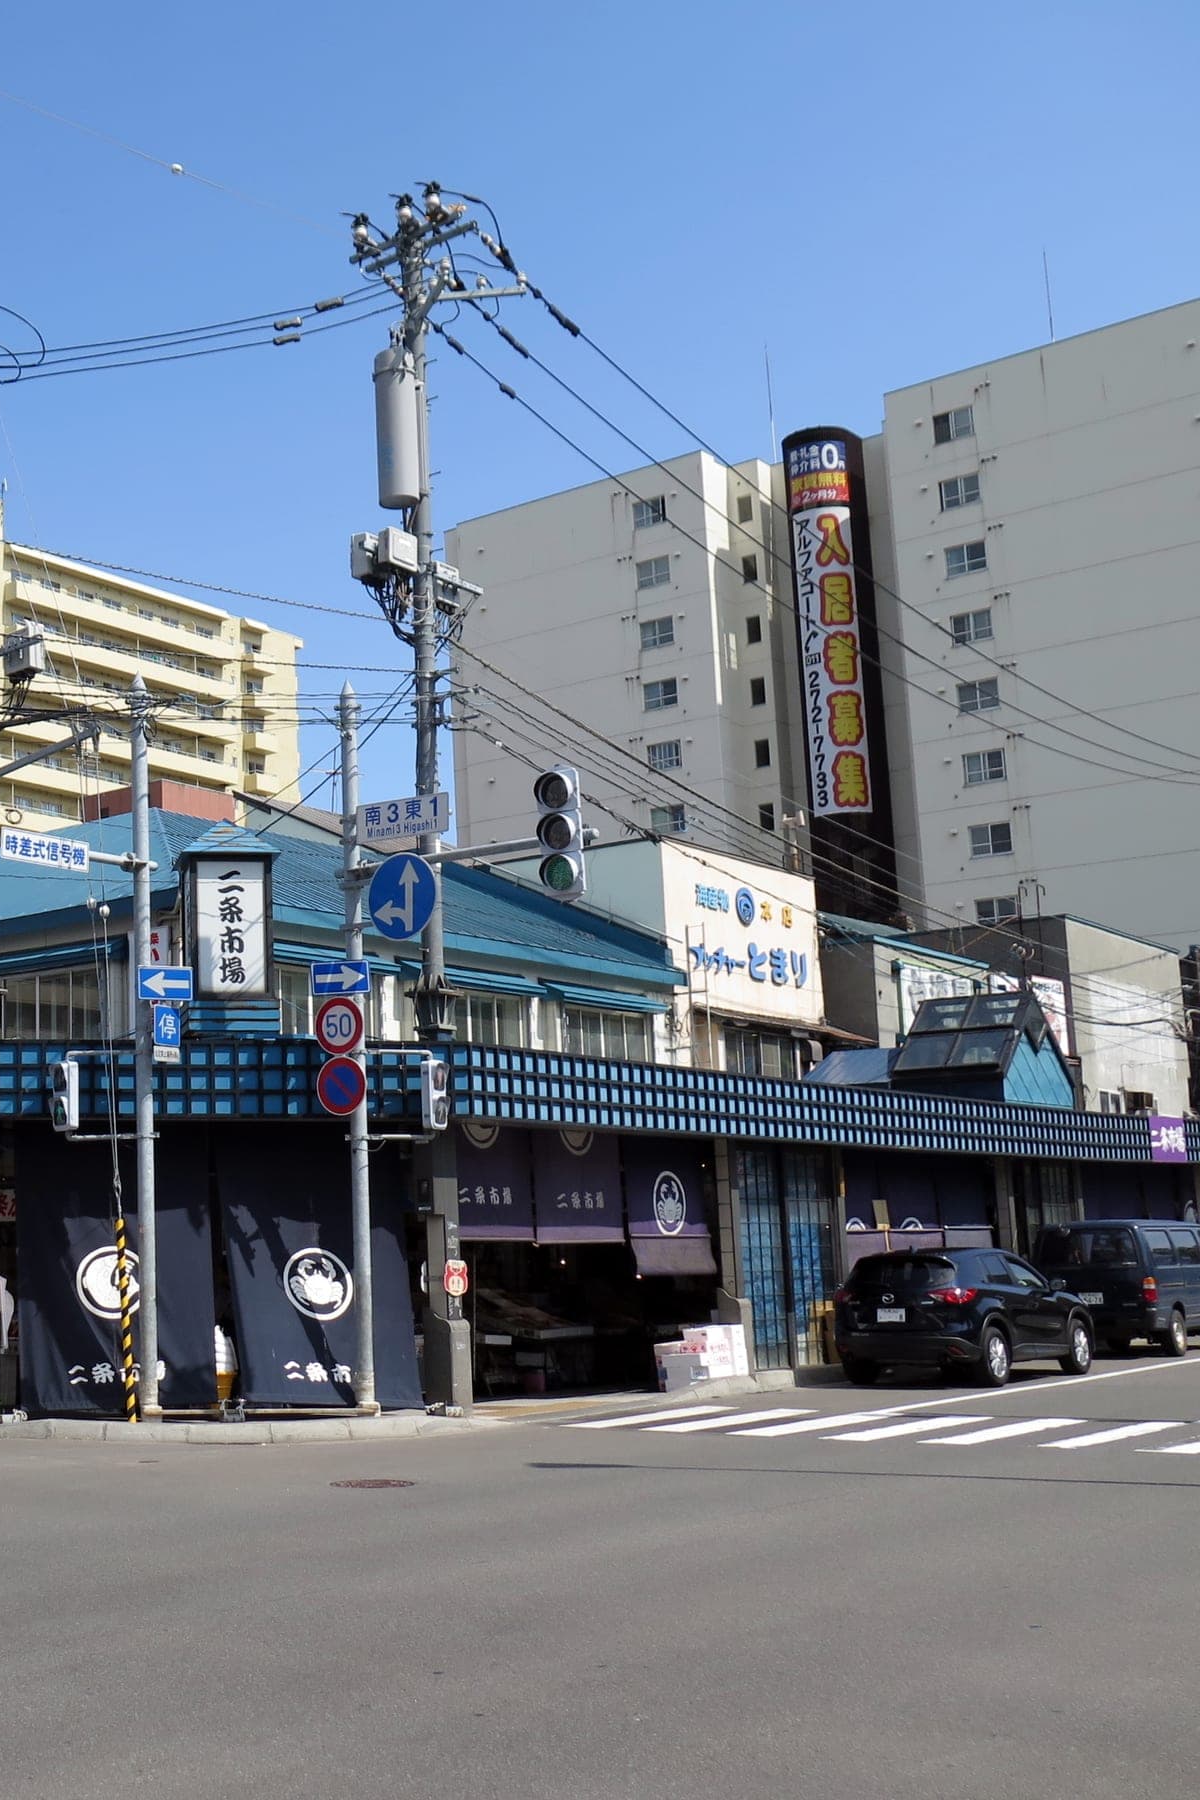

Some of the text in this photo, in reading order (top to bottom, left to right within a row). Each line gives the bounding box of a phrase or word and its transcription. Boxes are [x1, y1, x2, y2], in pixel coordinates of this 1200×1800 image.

[795, 518, 816, 632] アルファコート
[816, 512, 870, 808] 入居者募集
[365, 795, 438, 827] 南3東1
[4, 834, 87, 867] 時差式信号機
[217, 870, 246, 985] 二条市場
[158, 1013, 178, 1041] 停
[325, 1013, 352, 1038] 50
[1151, 1125, 1186, 1153] 二条市場
[459, 1186, 513, 1205] 二条市場
[557, 1191, 605, 1208] 二条市場
[68, 1359, 167, 1385] 二条市
[283, 1360, 353, 1384] 二条市
